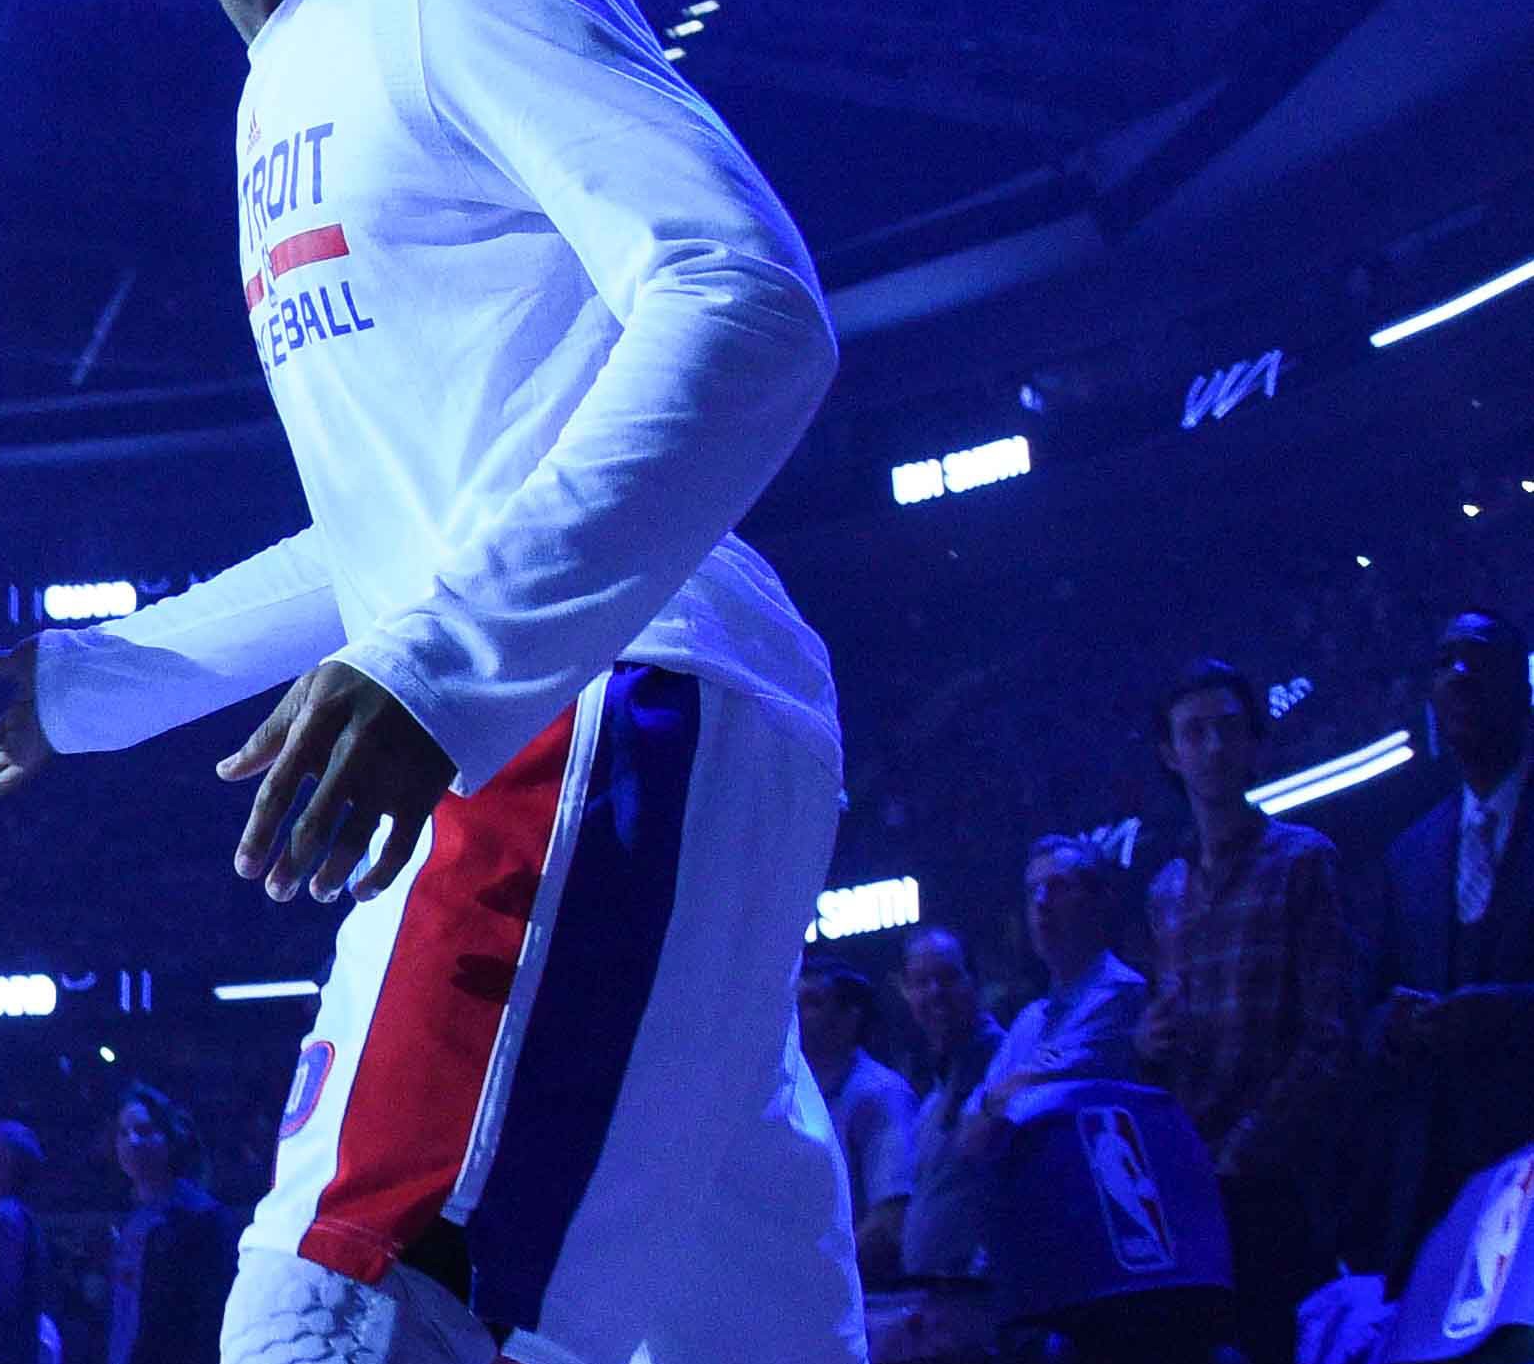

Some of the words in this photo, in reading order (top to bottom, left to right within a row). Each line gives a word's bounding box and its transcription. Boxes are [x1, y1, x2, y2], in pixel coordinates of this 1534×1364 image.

[240, 122, 334, 253] TROIT
[260, 281, 375, 370] EBALL
[816, 875, 920, 940] SMITH
